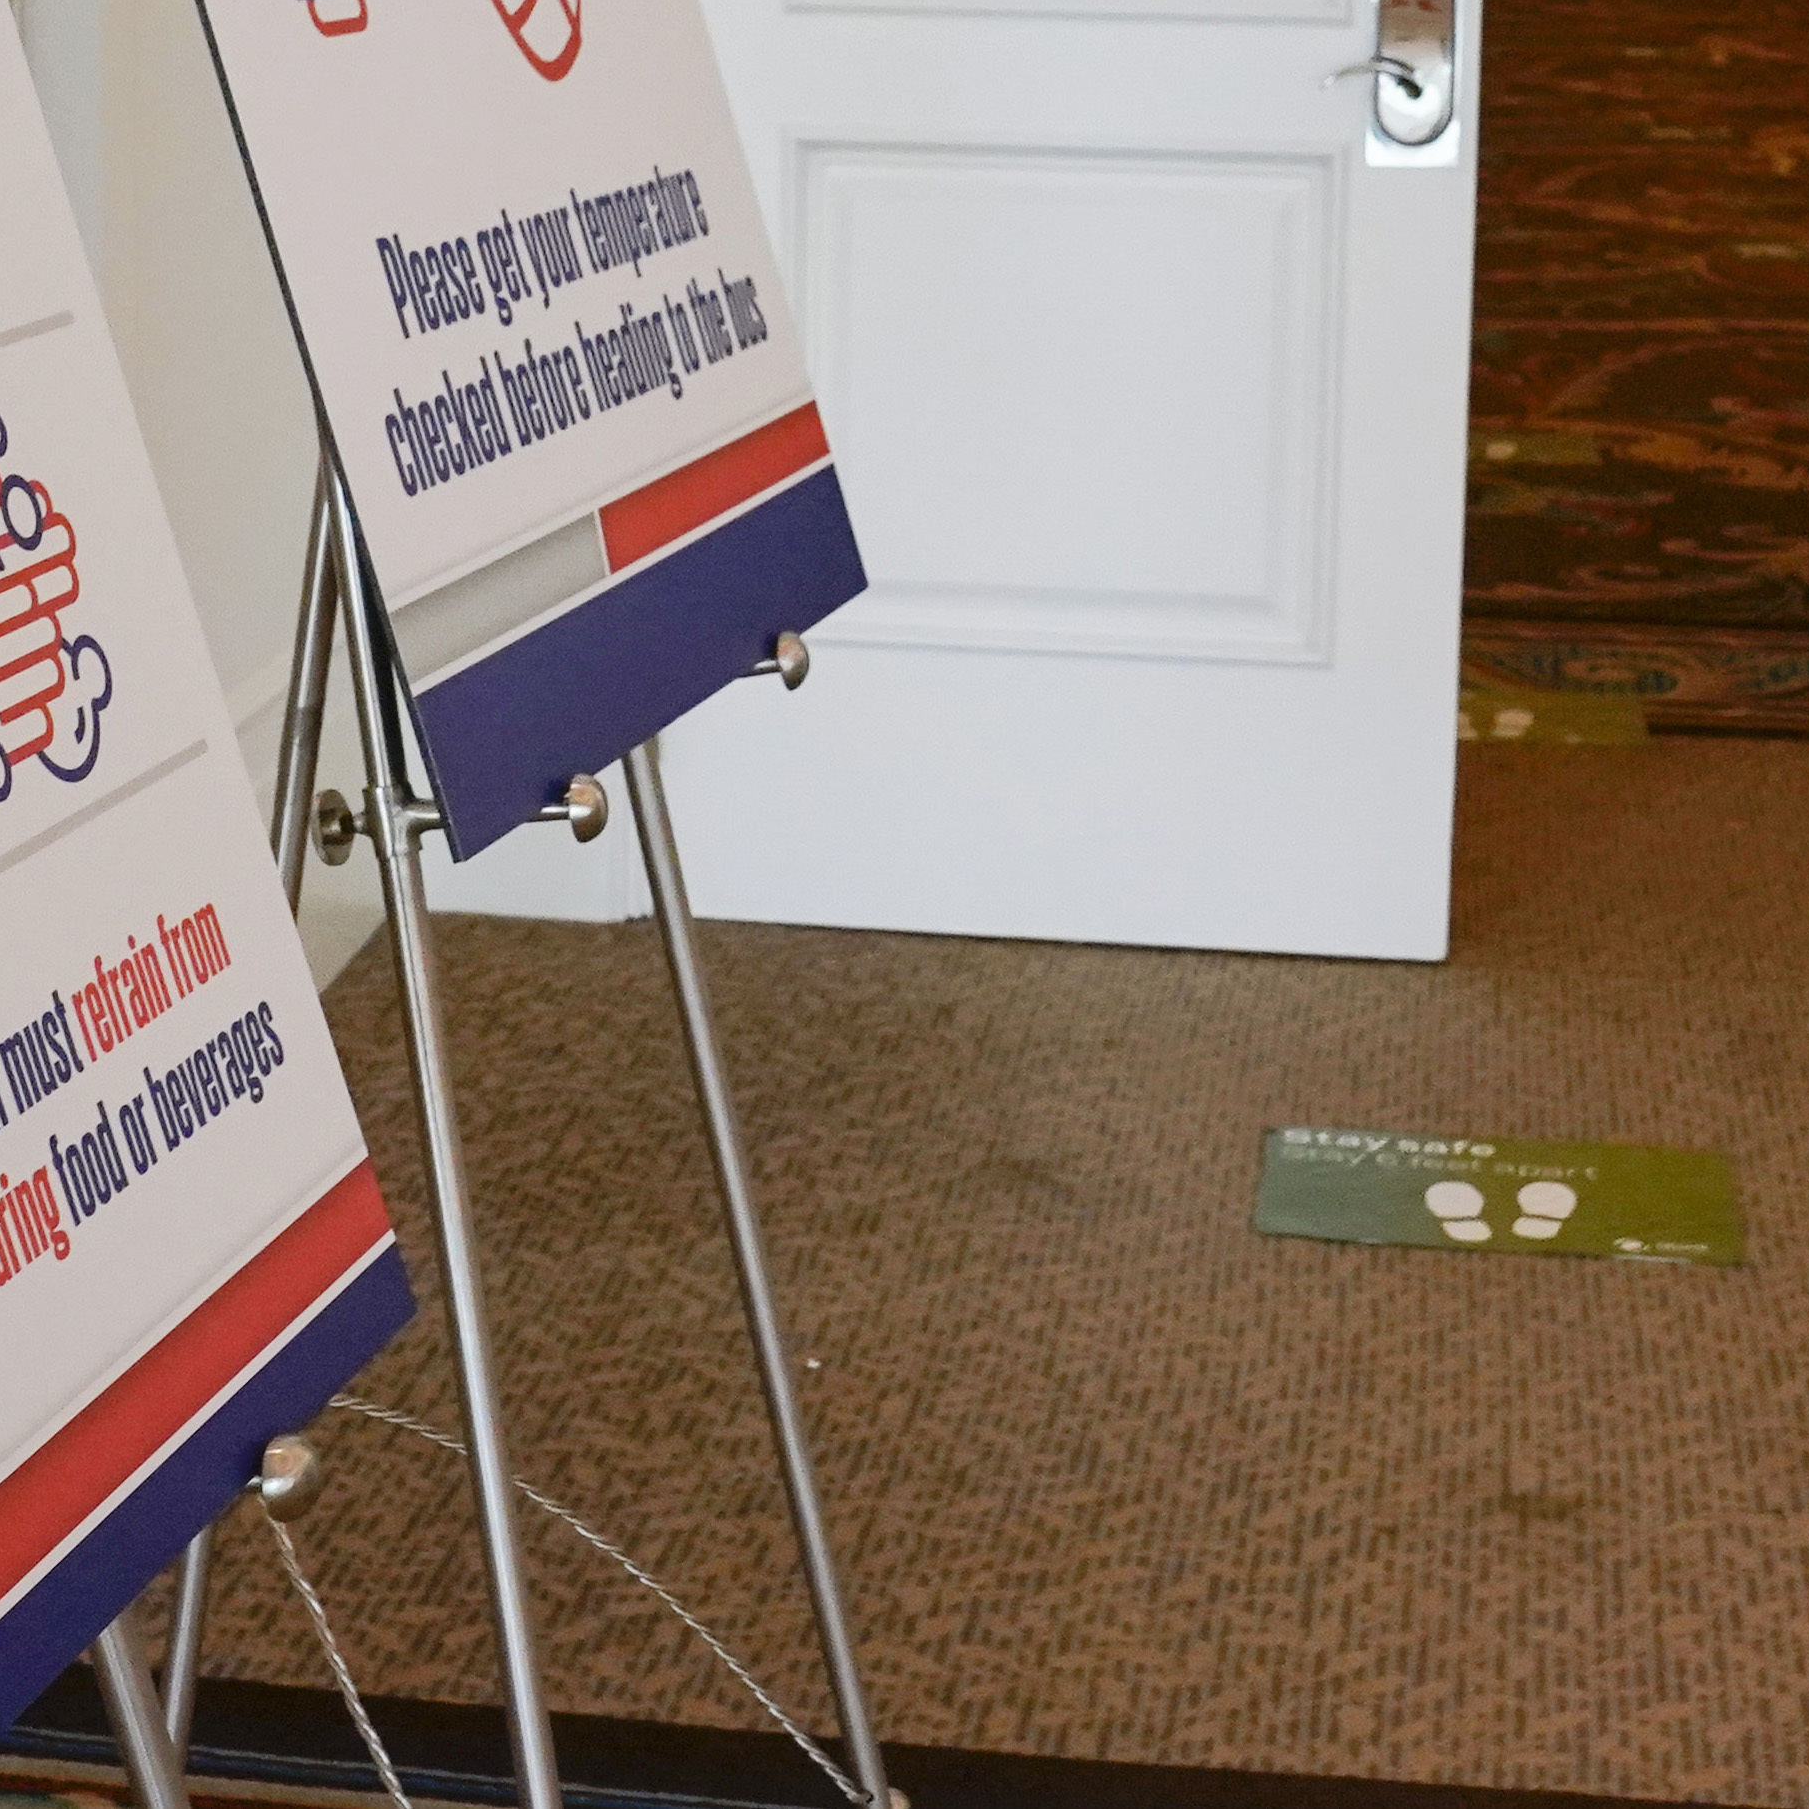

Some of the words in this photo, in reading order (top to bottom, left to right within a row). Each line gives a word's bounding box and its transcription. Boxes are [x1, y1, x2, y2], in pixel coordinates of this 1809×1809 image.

[375, 233, 486, 339] Please
[476, 208, 531, 327] get
[519, 206, 582, 309] your
[570, 165, 709, 277] temperature
[384, 351, 512, 496] checked
[495, 338, 591, 447] before
[575, 302, 682, 413] heading
[663, 293, 700, 374] to
[686, 277, 733, 364] the
[717, 268, 767, 349] bus
[71, 935, 172, 1062] refrain
[157, 903, 231, 1000] from
[49, 1101, 129, 1227] food
[119, 1093, 158, 1175] or
[143, 1001, 284, 1152] beverages
